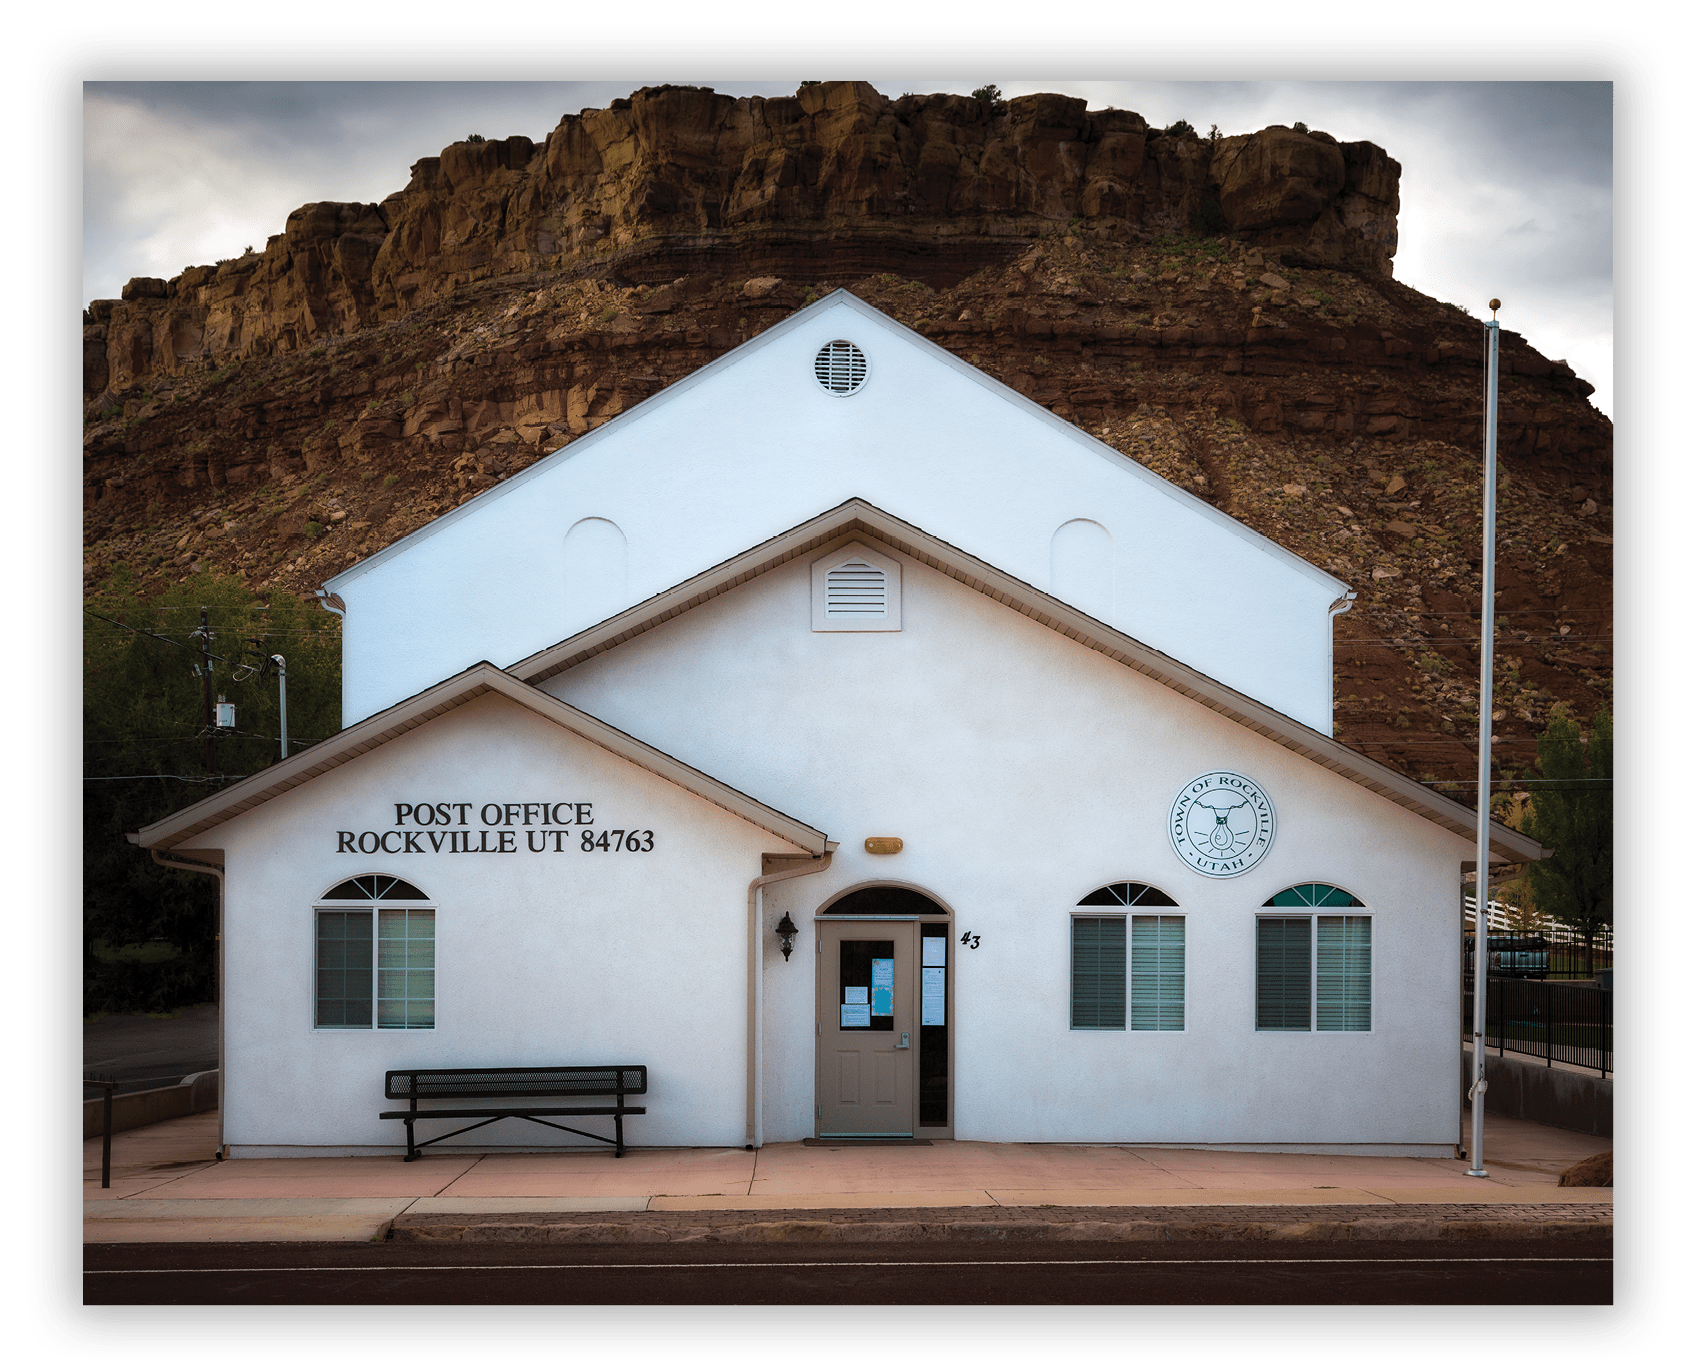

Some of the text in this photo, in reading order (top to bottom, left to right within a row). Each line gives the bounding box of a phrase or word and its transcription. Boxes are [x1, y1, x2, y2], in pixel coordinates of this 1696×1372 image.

[394, 803, 594, 826] POST OFFICE
[1175, 777, 1269, 847] TOWN OF ROCKVILLE
[336, 829, 655, 854] ROCKVILLE UT 84763
[1196, 857, 1244, 871] UTAH
[960, 931, 981, 950] 43
